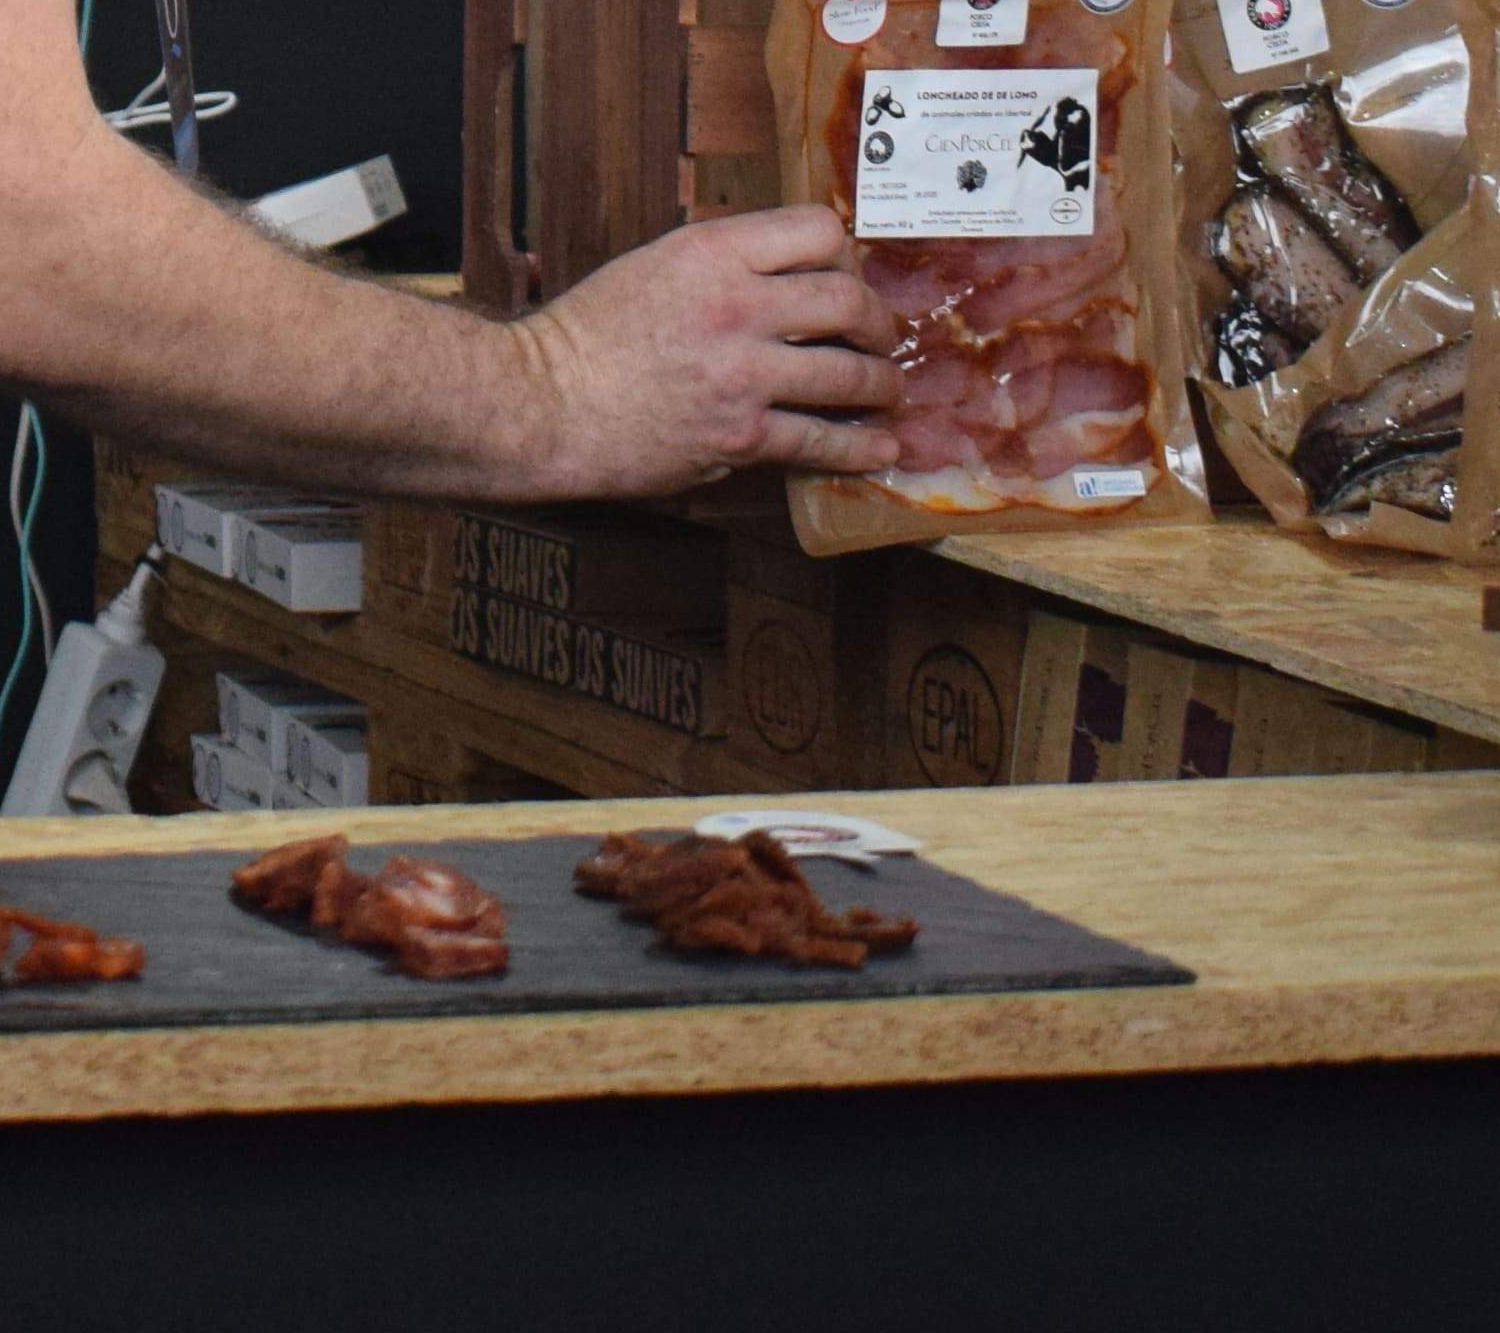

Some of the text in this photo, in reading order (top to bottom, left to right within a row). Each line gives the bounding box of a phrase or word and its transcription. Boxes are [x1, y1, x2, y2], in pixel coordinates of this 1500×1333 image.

[917, 90, 979, 101] LONCHEADO
[981, 91, 995, 100] DE
[1010, 90, 1038, 100] LOMO
[486, 524, 571, 611] SUAVES
[449, 585, 480, 655] OS
[485, 596, 571, 686] SUAVES
[575, 623, 605, 697] OS
[612, 636, 698, 731] SUAVES
[922, 676, 990, 773] EPAL
